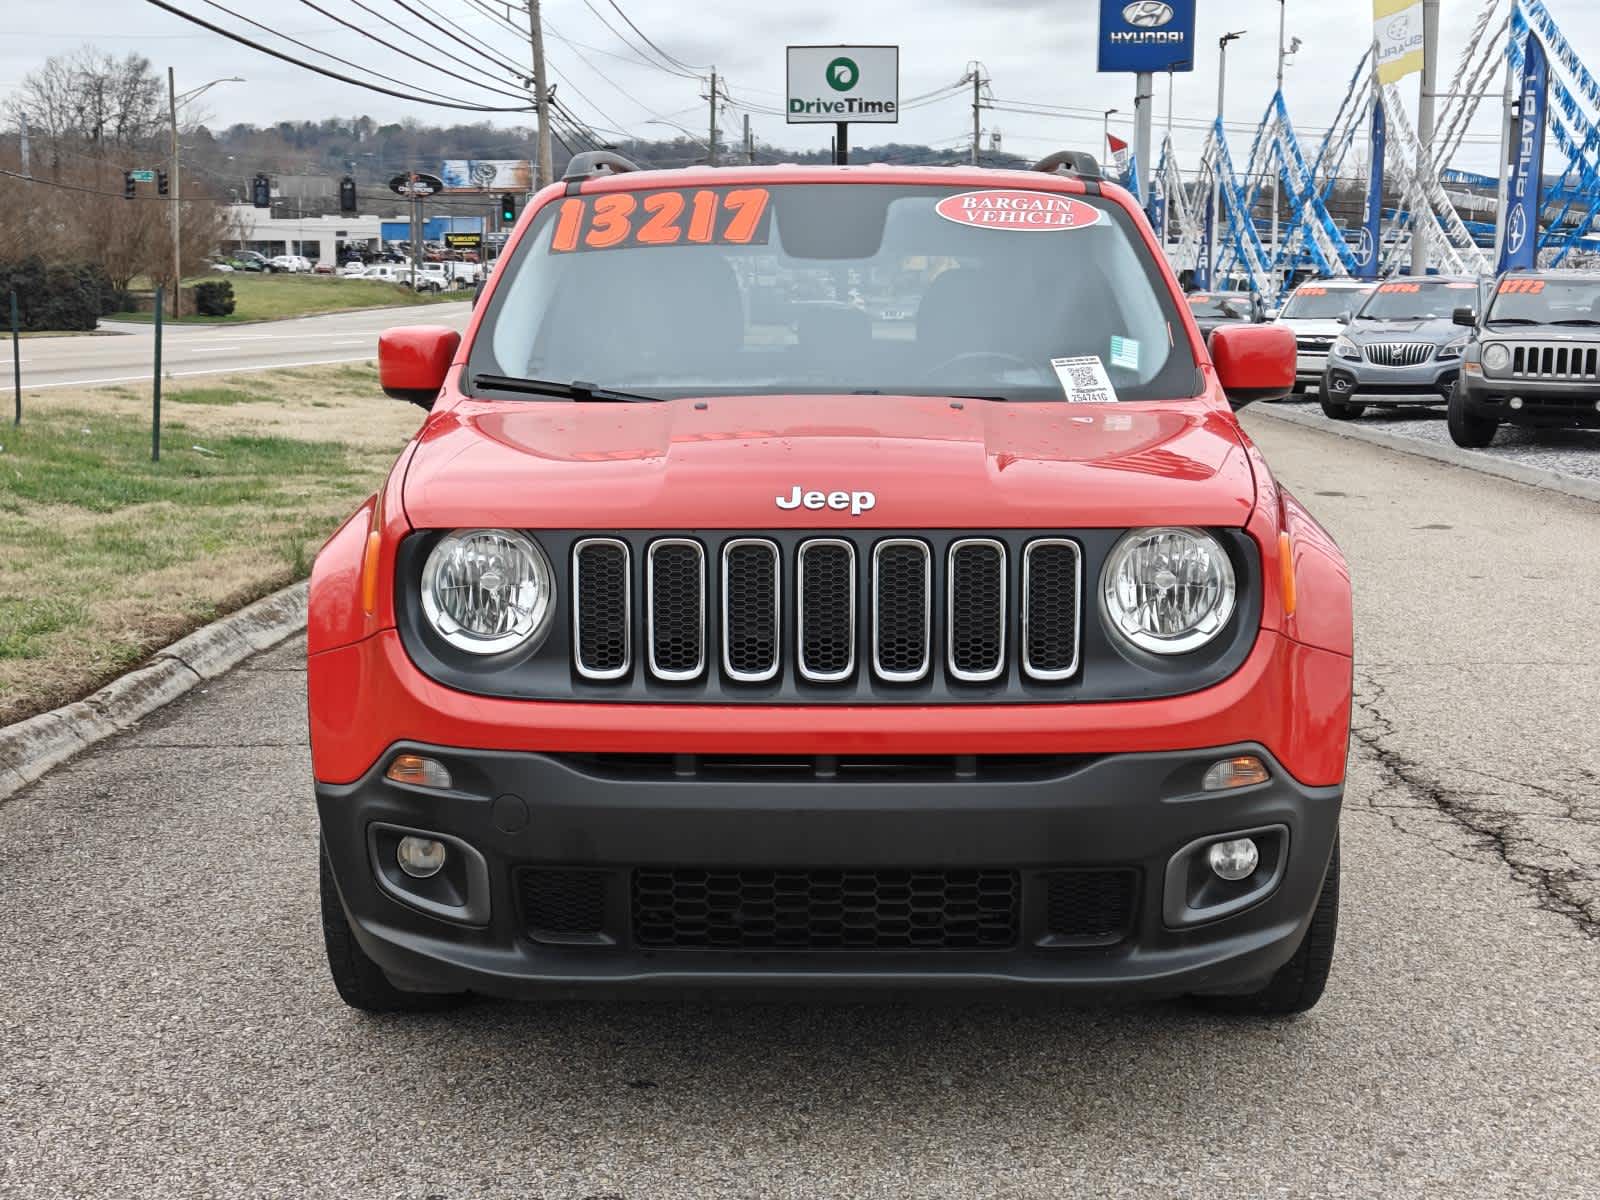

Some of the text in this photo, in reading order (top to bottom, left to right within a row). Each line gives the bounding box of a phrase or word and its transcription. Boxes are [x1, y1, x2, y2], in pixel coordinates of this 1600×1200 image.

[1110, 31, 1184, 44] HYUNDAI
[788, 97, 896, 114] DriveTime
[961, 196, 1073, 213] BARGAIN
[552, 187, 770, 251] 13217
[964, 209, 1075, 226] VEHICLE
[775, 485, 876, 516] Jeep
